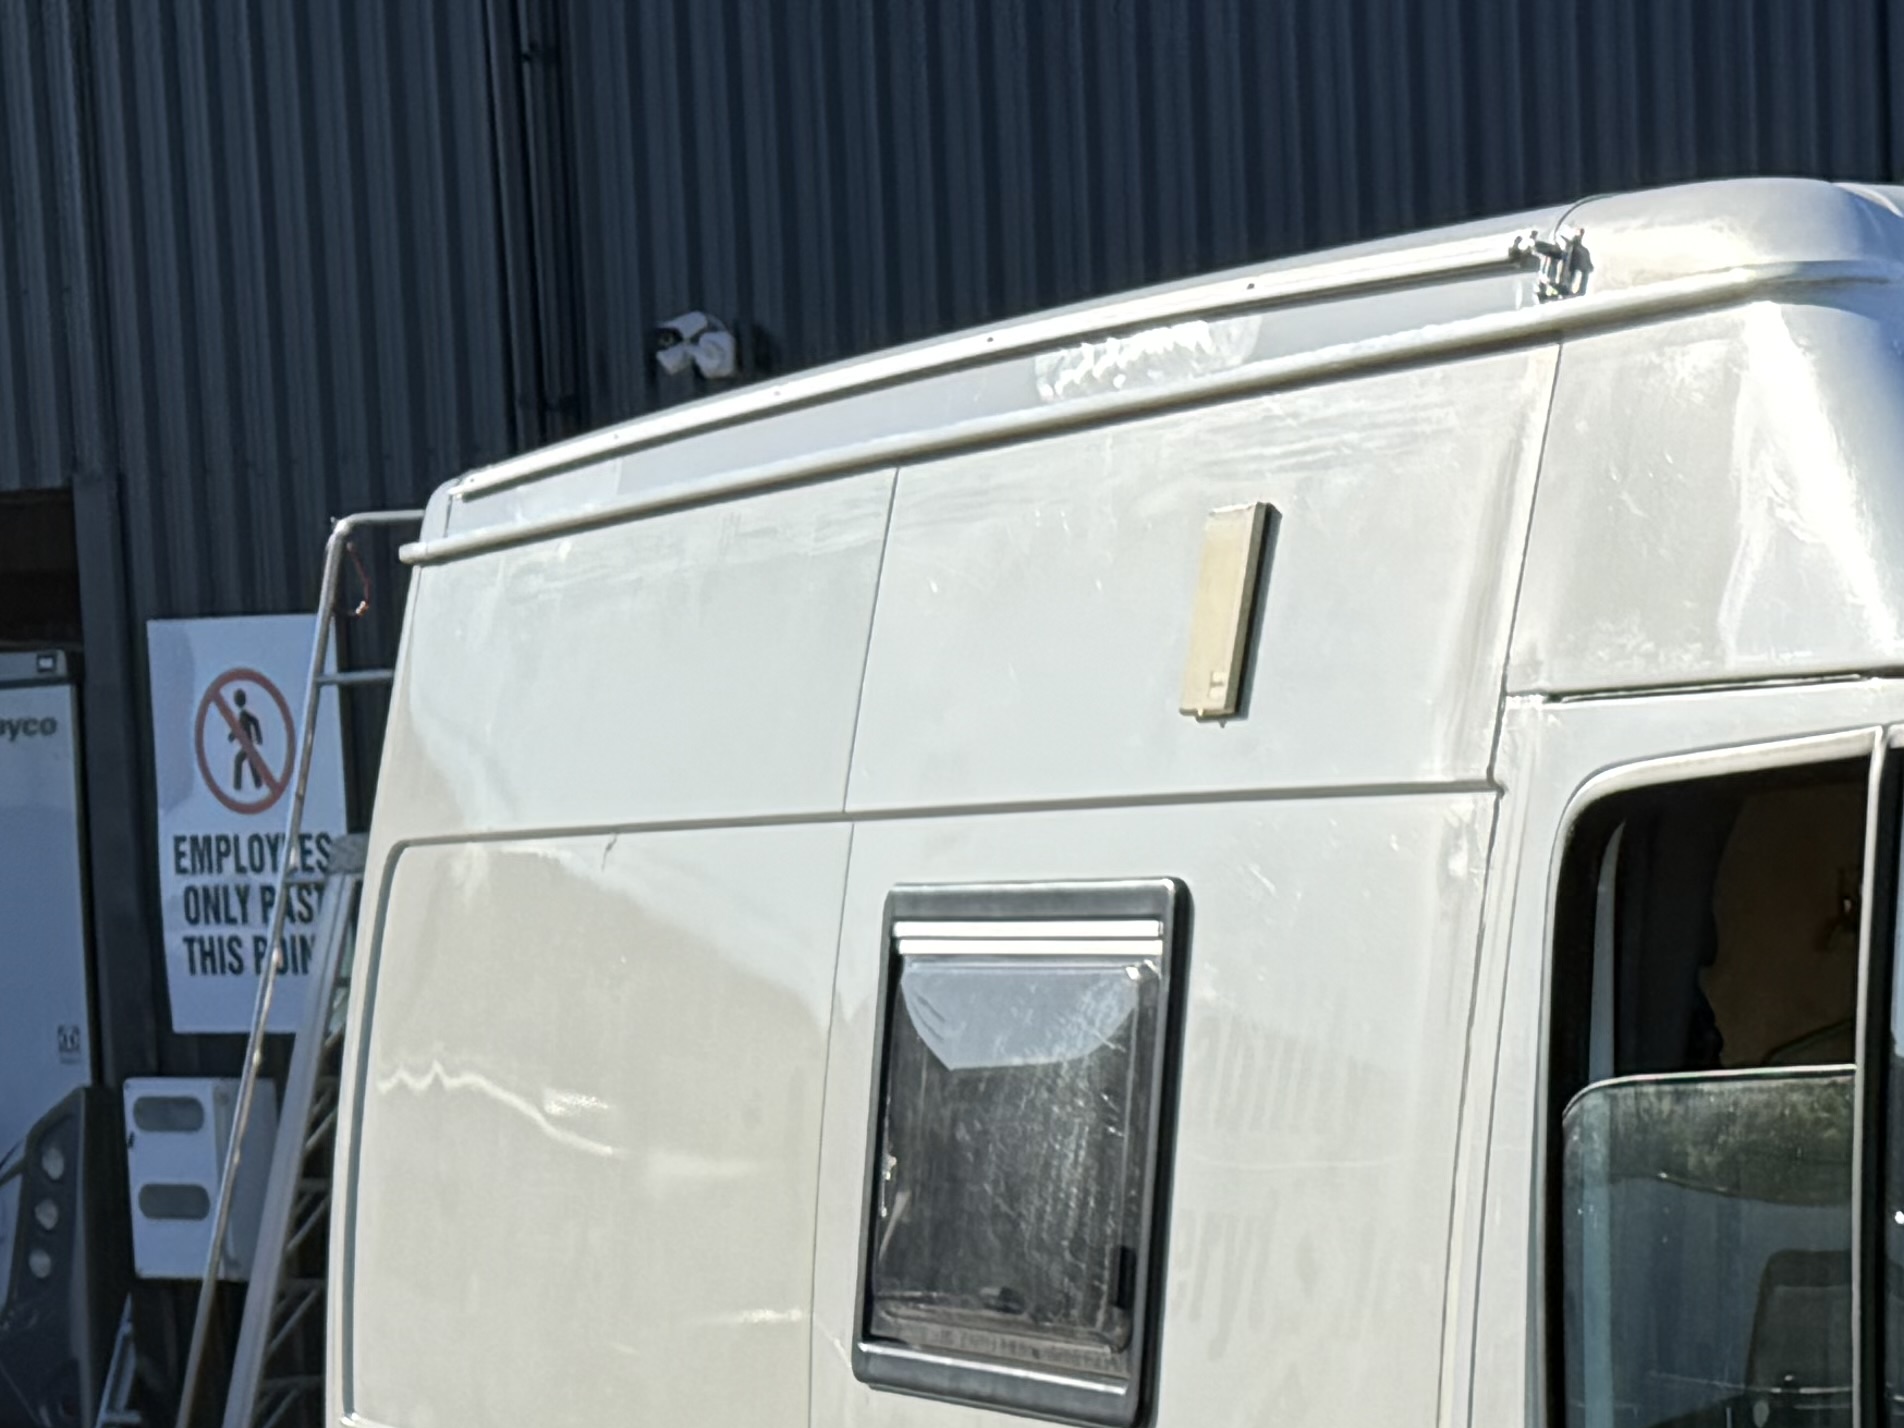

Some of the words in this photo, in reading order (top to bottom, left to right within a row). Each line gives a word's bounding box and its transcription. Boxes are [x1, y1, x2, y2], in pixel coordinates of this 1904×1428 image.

[173, 832, 333, 875] EMPLOYES
[183, 884, 253, 925] ONLY
[182, 933, 244, 976] THIS
